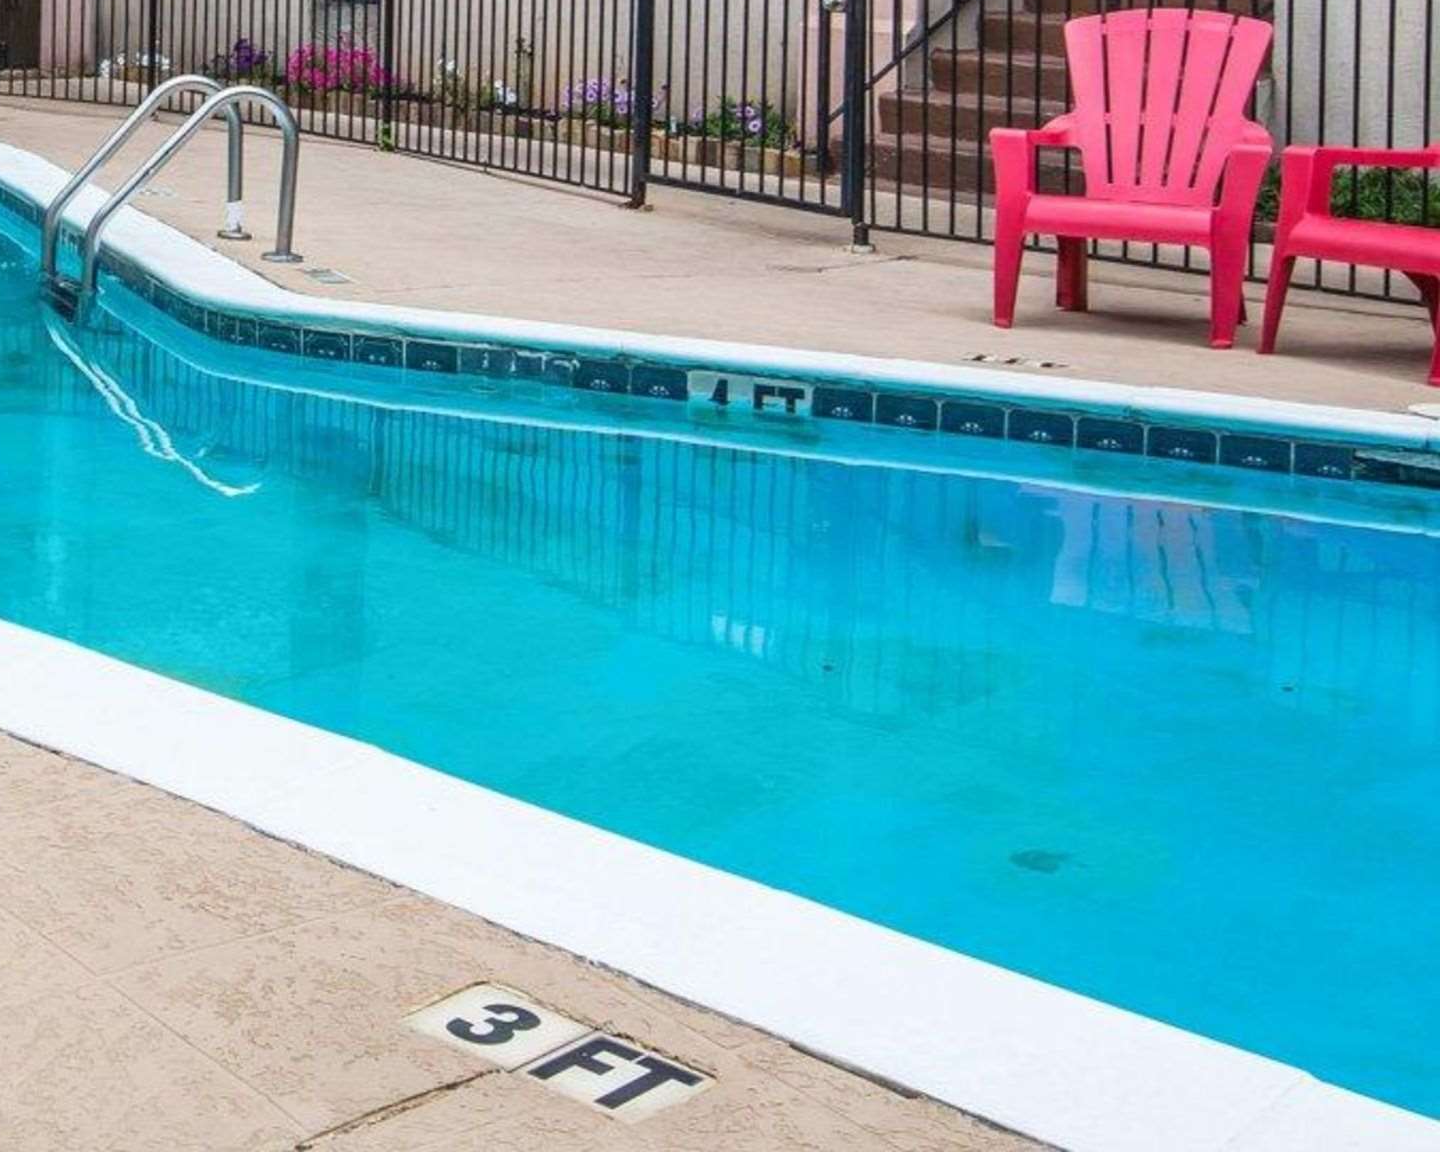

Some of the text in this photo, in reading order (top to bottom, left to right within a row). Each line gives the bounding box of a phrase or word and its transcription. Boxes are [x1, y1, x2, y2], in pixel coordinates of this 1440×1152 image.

[708, 378, 806, 415] 4 FT
[445, 1003, 703, 1110] 3 FT
